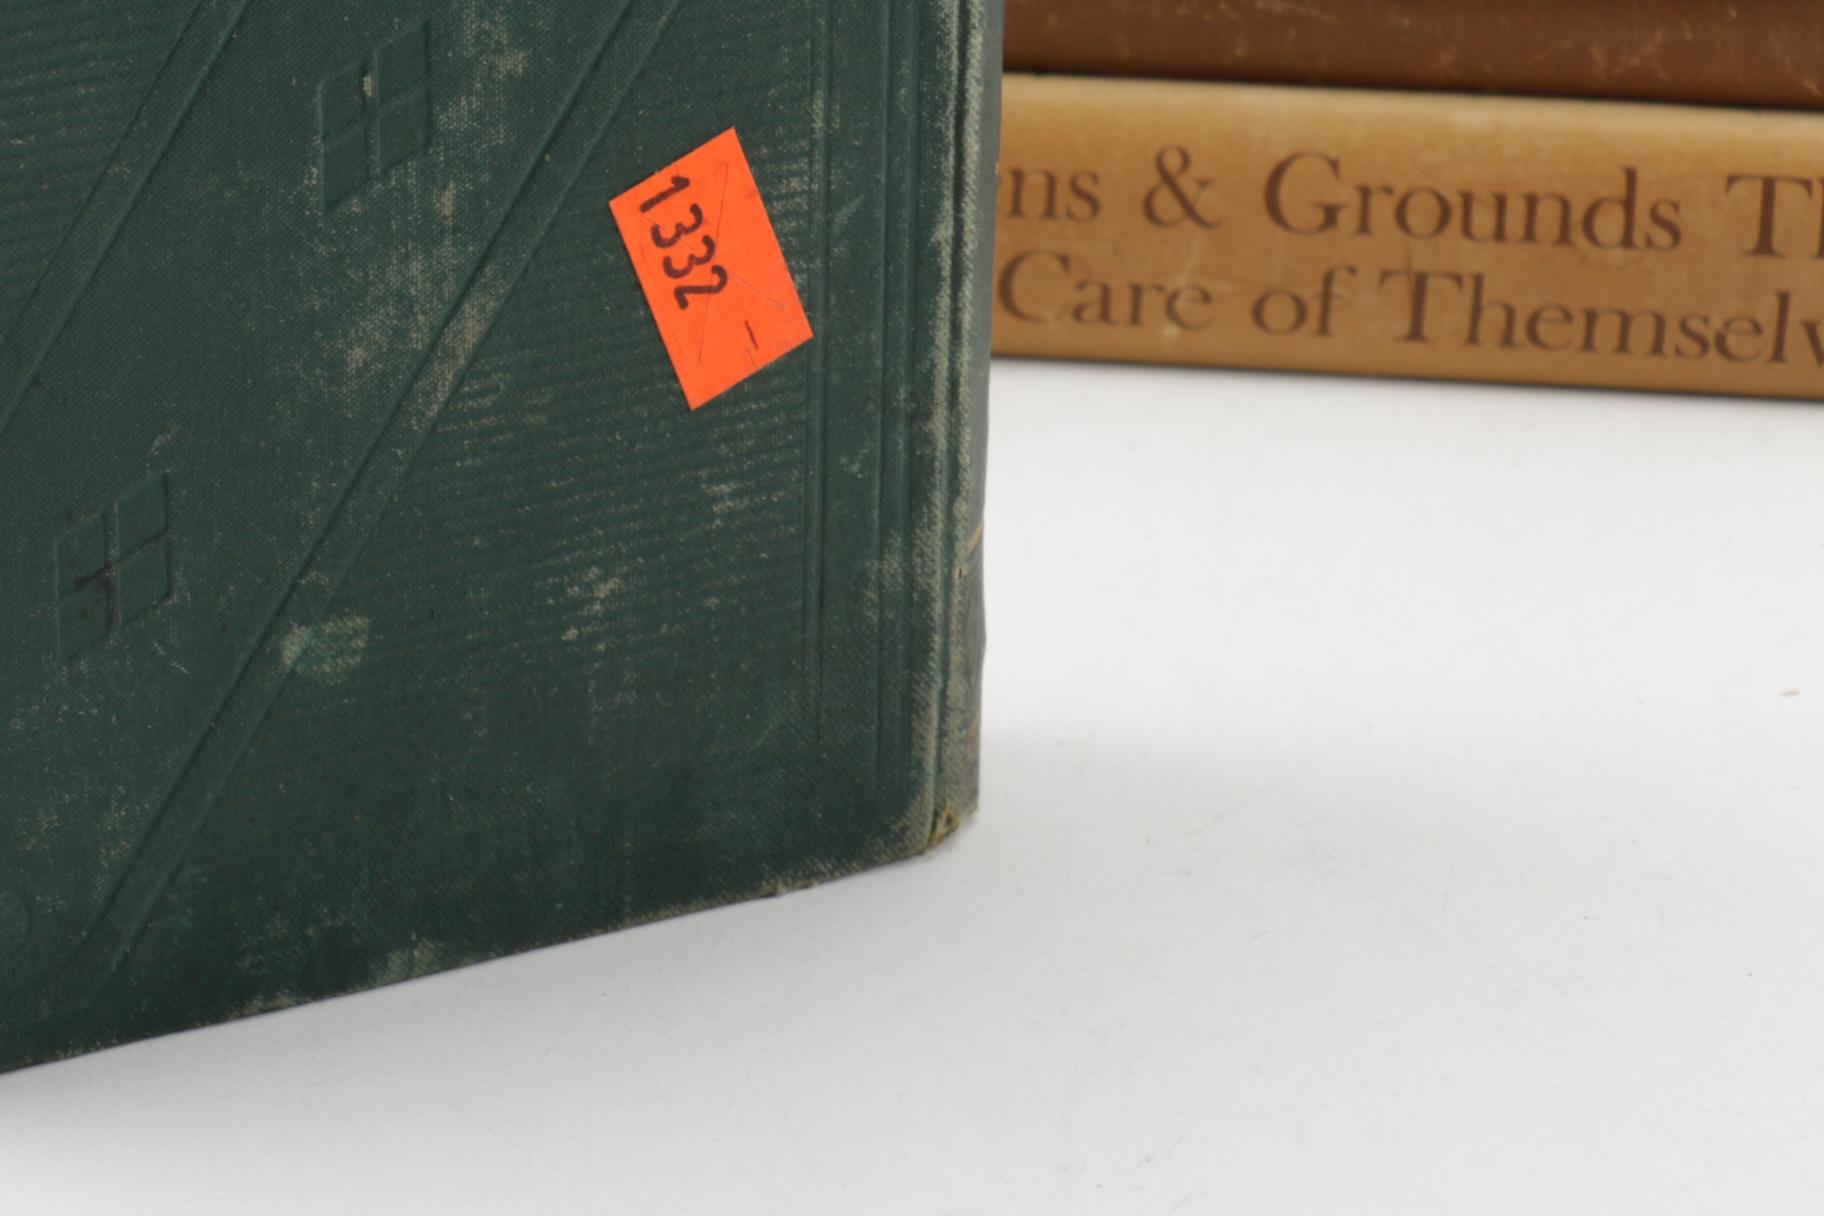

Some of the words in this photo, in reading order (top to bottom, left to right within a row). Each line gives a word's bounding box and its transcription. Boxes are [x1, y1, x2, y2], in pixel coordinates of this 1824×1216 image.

[639, 175, 729, 310] 1332
[1141, 144, 1222, 230] &
[1264, 150, 1683, 252] Grounds
[997, 248, 1213, 331] Care
[1250, 263, 1359, 338] of
